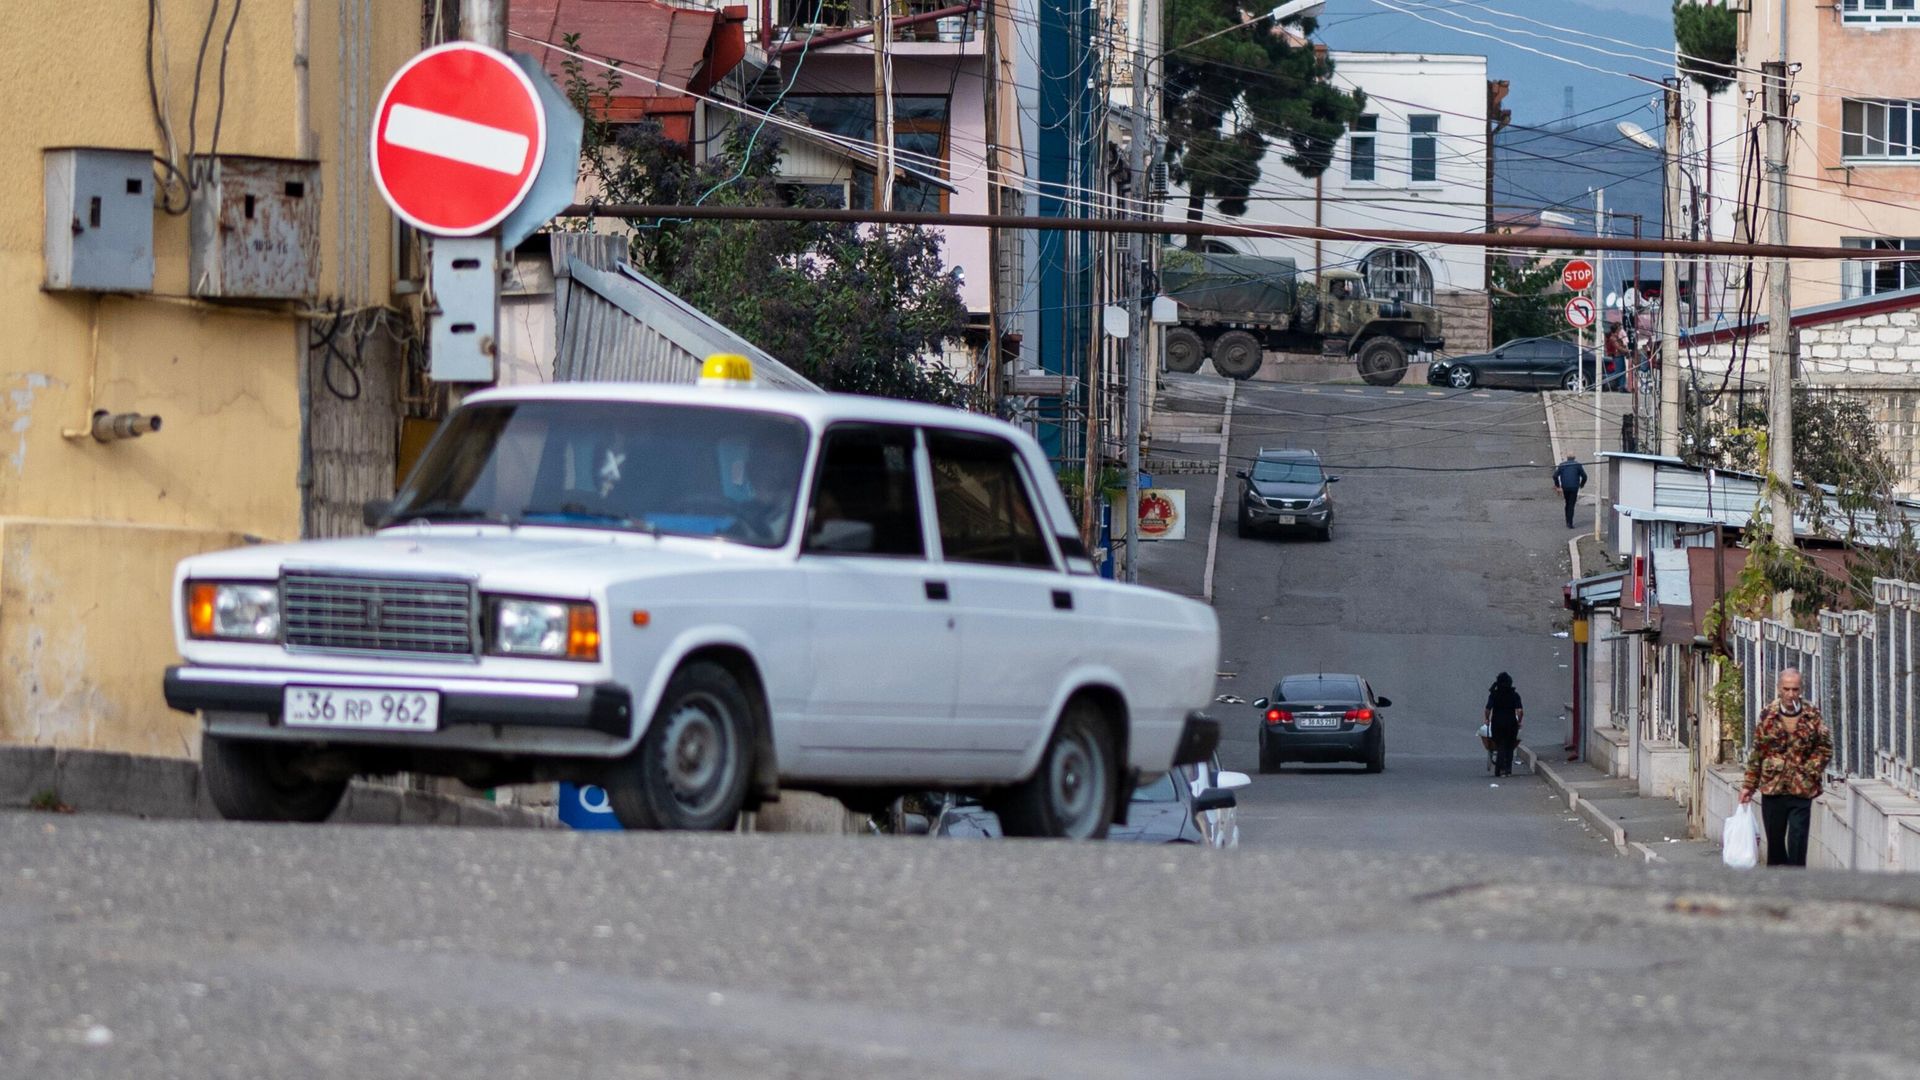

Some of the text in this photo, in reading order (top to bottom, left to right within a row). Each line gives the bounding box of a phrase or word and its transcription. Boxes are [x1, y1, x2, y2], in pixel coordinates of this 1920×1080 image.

[1565, 270, 1591, 282] STOP
[307, 690, 427, 724] 36 RP 962
